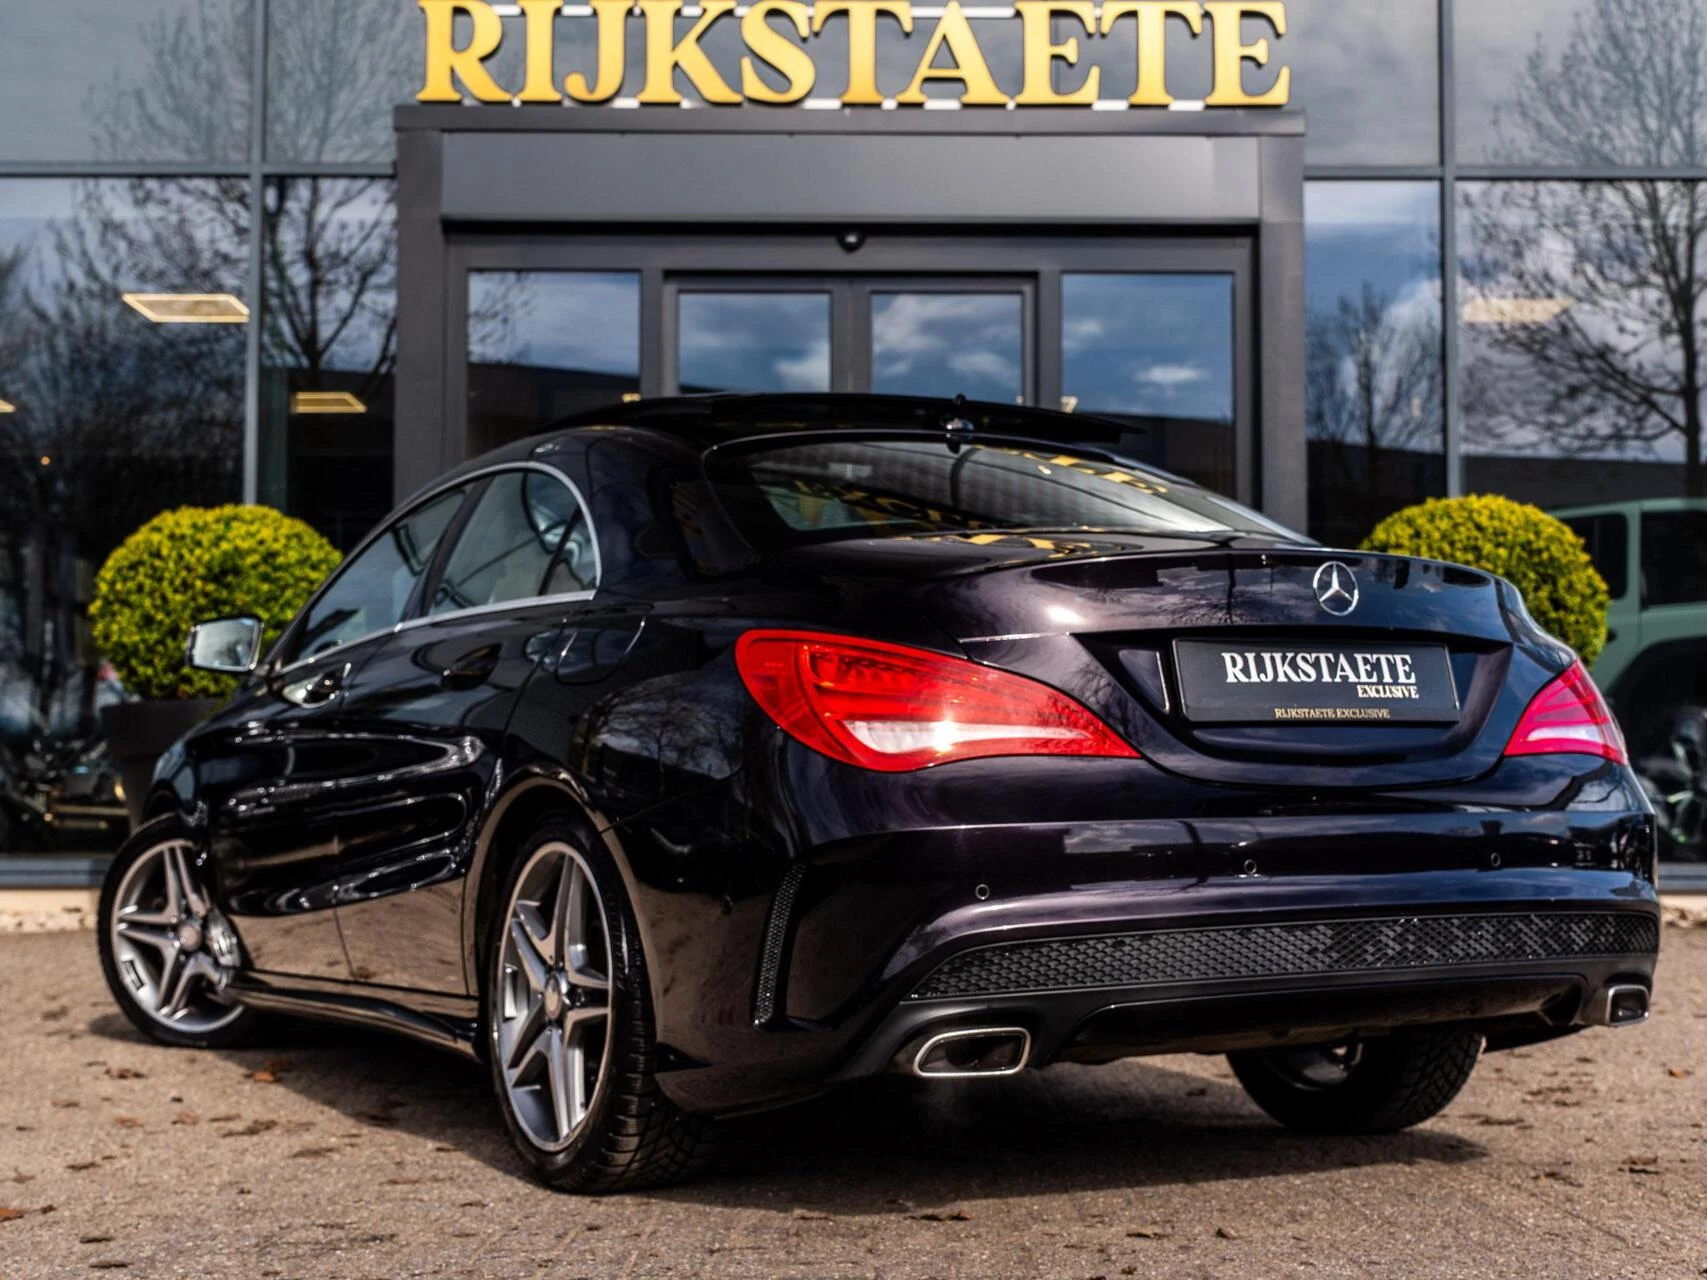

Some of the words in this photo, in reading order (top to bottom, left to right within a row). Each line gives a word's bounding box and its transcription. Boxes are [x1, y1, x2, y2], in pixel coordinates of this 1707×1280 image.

[416, 1, 1291, 106] RIJKSTAETE
[1221, 652, 1416, 683] RIJKSTAETE
[1357, 685, 1419, 699] EXCLUSIVE
[1274, 708, 1335, 719] RIJKSTAETE
[1336, 709, 1390, 719] EXCLUSIVE
